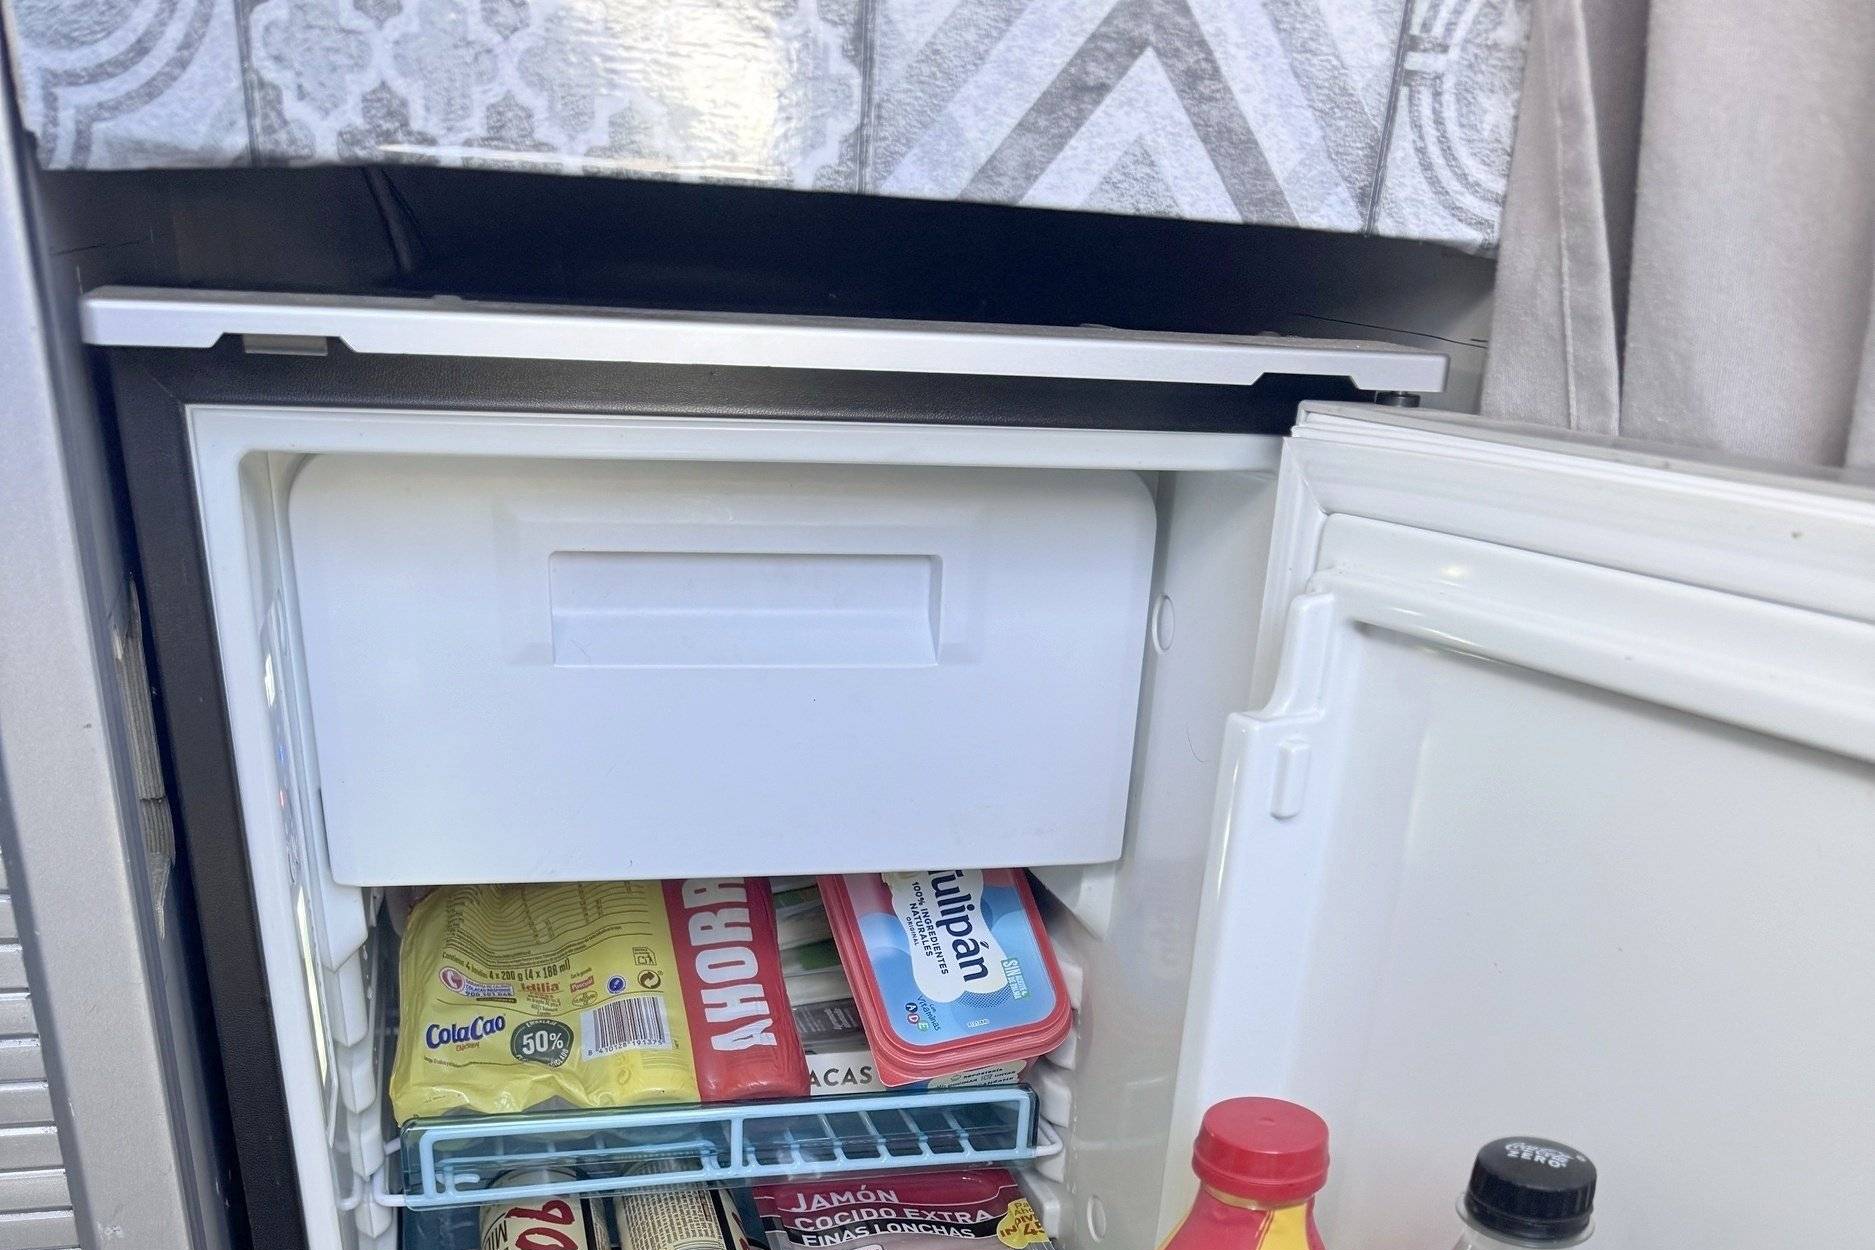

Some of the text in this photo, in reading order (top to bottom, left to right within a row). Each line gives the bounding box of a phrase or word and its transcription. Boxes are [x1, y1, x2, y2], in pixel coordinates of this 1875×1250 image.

[906, 916, 919, 946] ORIGINAL
[909, 902, 933, 957] NATURALES
[912, 881, 949, 975] 100% INGREDIENTES
[682, 880, 777, 1051] AHORR
[426, 1015, 506, 1049] ColaCao
[522, 1031, 564, 1055] 50%
[810, 1066, 873, 1087] ACAS
[1507, 1151, 1560, 1168] ZERO
[791, 1185, 898, 1212] JAMÓN
[794, 1208, 993, 1232] COCIDO EXTRA
[801, 1223, 976, 1248] FINAS LONCHAS
